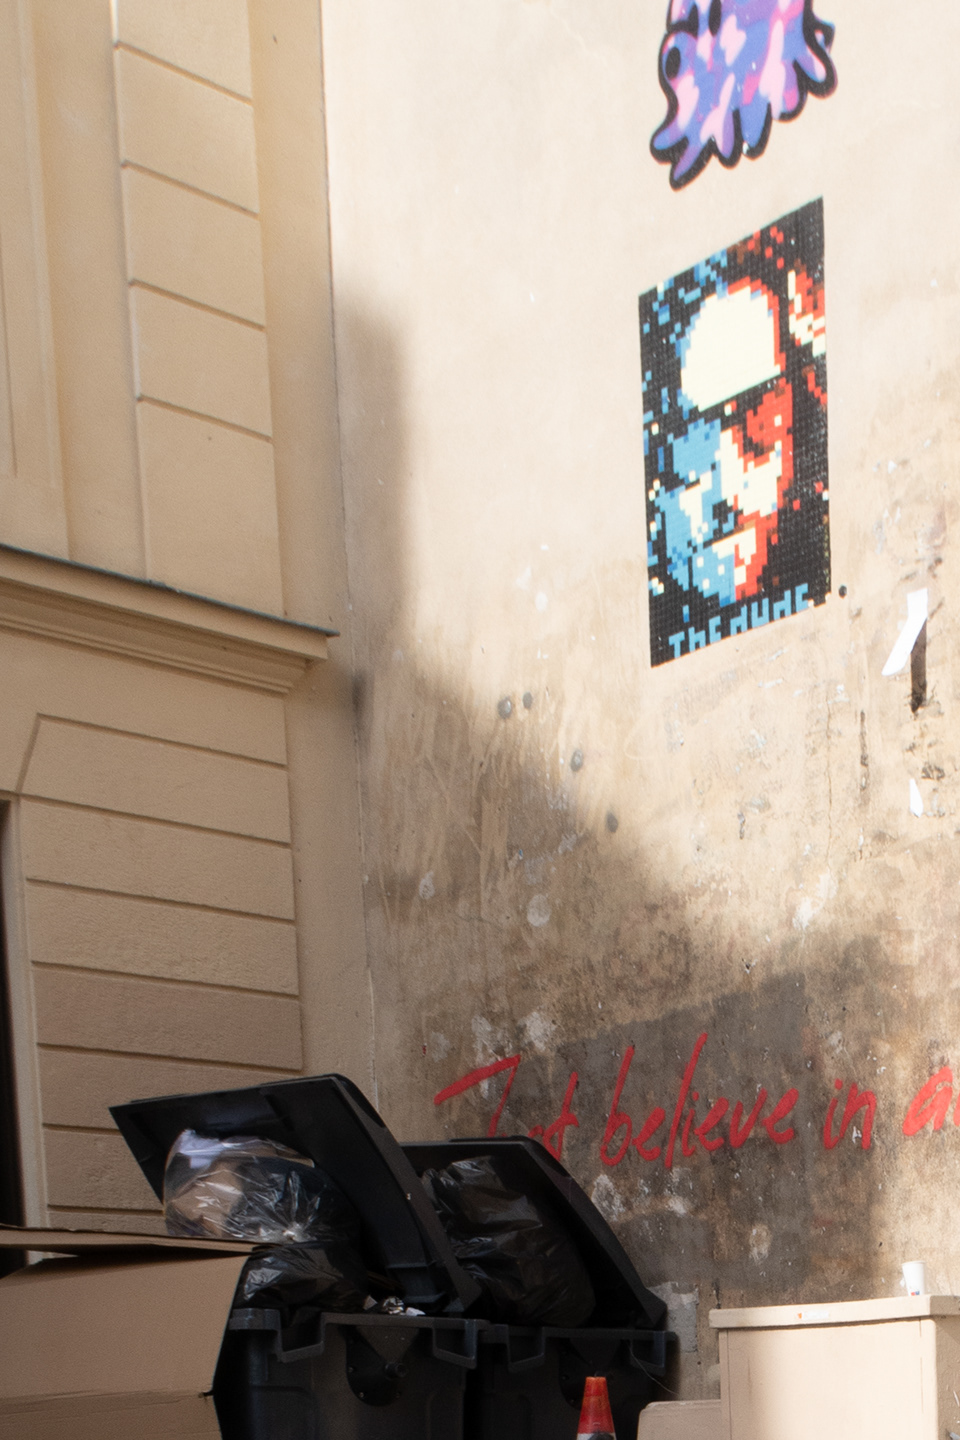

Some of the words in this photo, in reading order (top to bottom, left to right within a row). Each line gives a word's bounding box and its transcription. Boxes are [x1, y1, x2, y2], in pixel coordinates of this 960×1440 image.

[433, 1054, 579, 1161] Jt
[600, 1032, 799, 1169] believe
[823, 1078, 878, 1150] in
